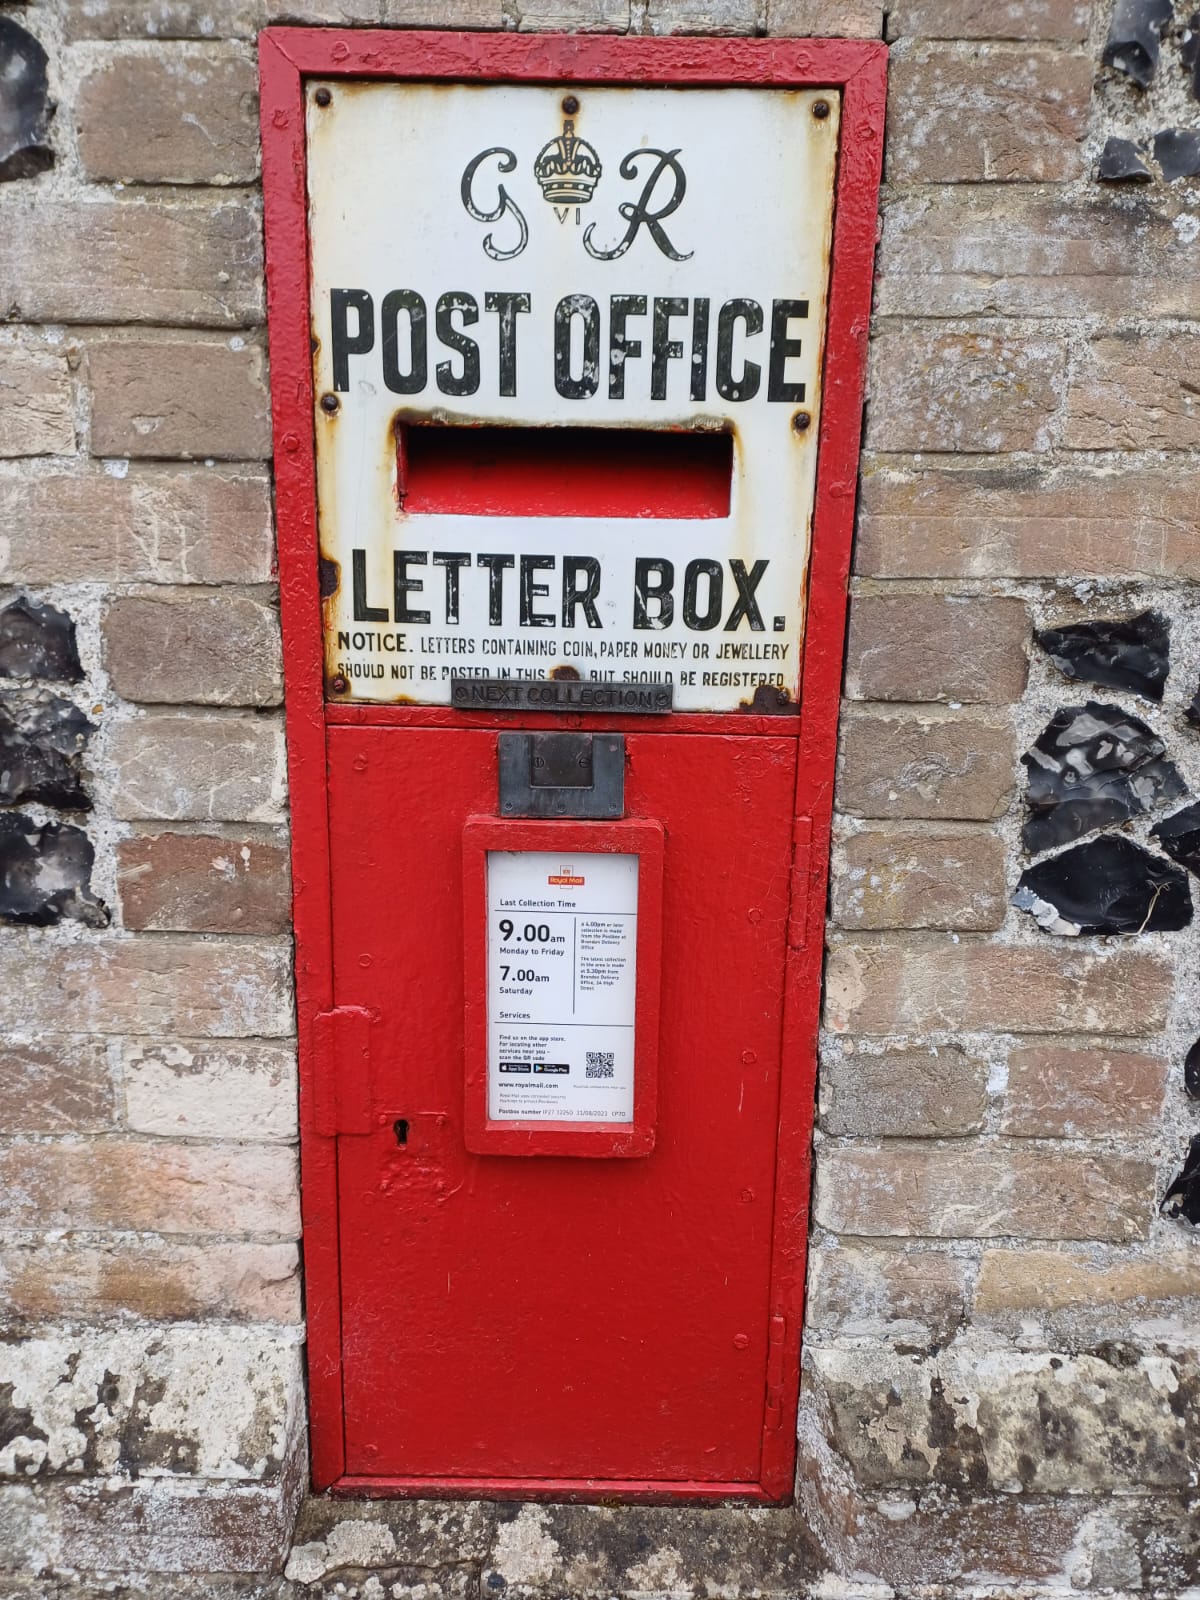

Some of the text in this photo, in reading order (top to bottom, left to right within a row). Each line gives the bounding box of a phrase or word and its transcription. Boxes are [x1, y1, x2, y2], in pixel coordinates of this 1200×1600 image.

[461, 147, 694, 262] G R
[553, 207, 581, 226] VI
[330, 288, 810, 404] POST OFFICE
[352, 548, 786, 632] LETTER BOX.
[337, 631, 790, 660] NOTICE. LETTERS CONTAINING COIN, PAPER MONEY OR JEWELLERY
[337, 663, 784, 688] SHOULD NOT BE POSTED IN THIS BUT SHOULD BE REGISTERED
[471, 685, 652, 708] NEXT COLLECTION
[549, 876, 584, 885] Royal Mail
[500, 898, 576, 908] Last Collection Time
[499, 918, 566, 944] 9.00am
[499, 947, 529, 956] Monday
[541, 948, 565, 957] Friday
[499, 965, 550, 983] 7.00am
[499, 986, 533, 996] Saturday
[499, 1011, 531, 1020] Services
